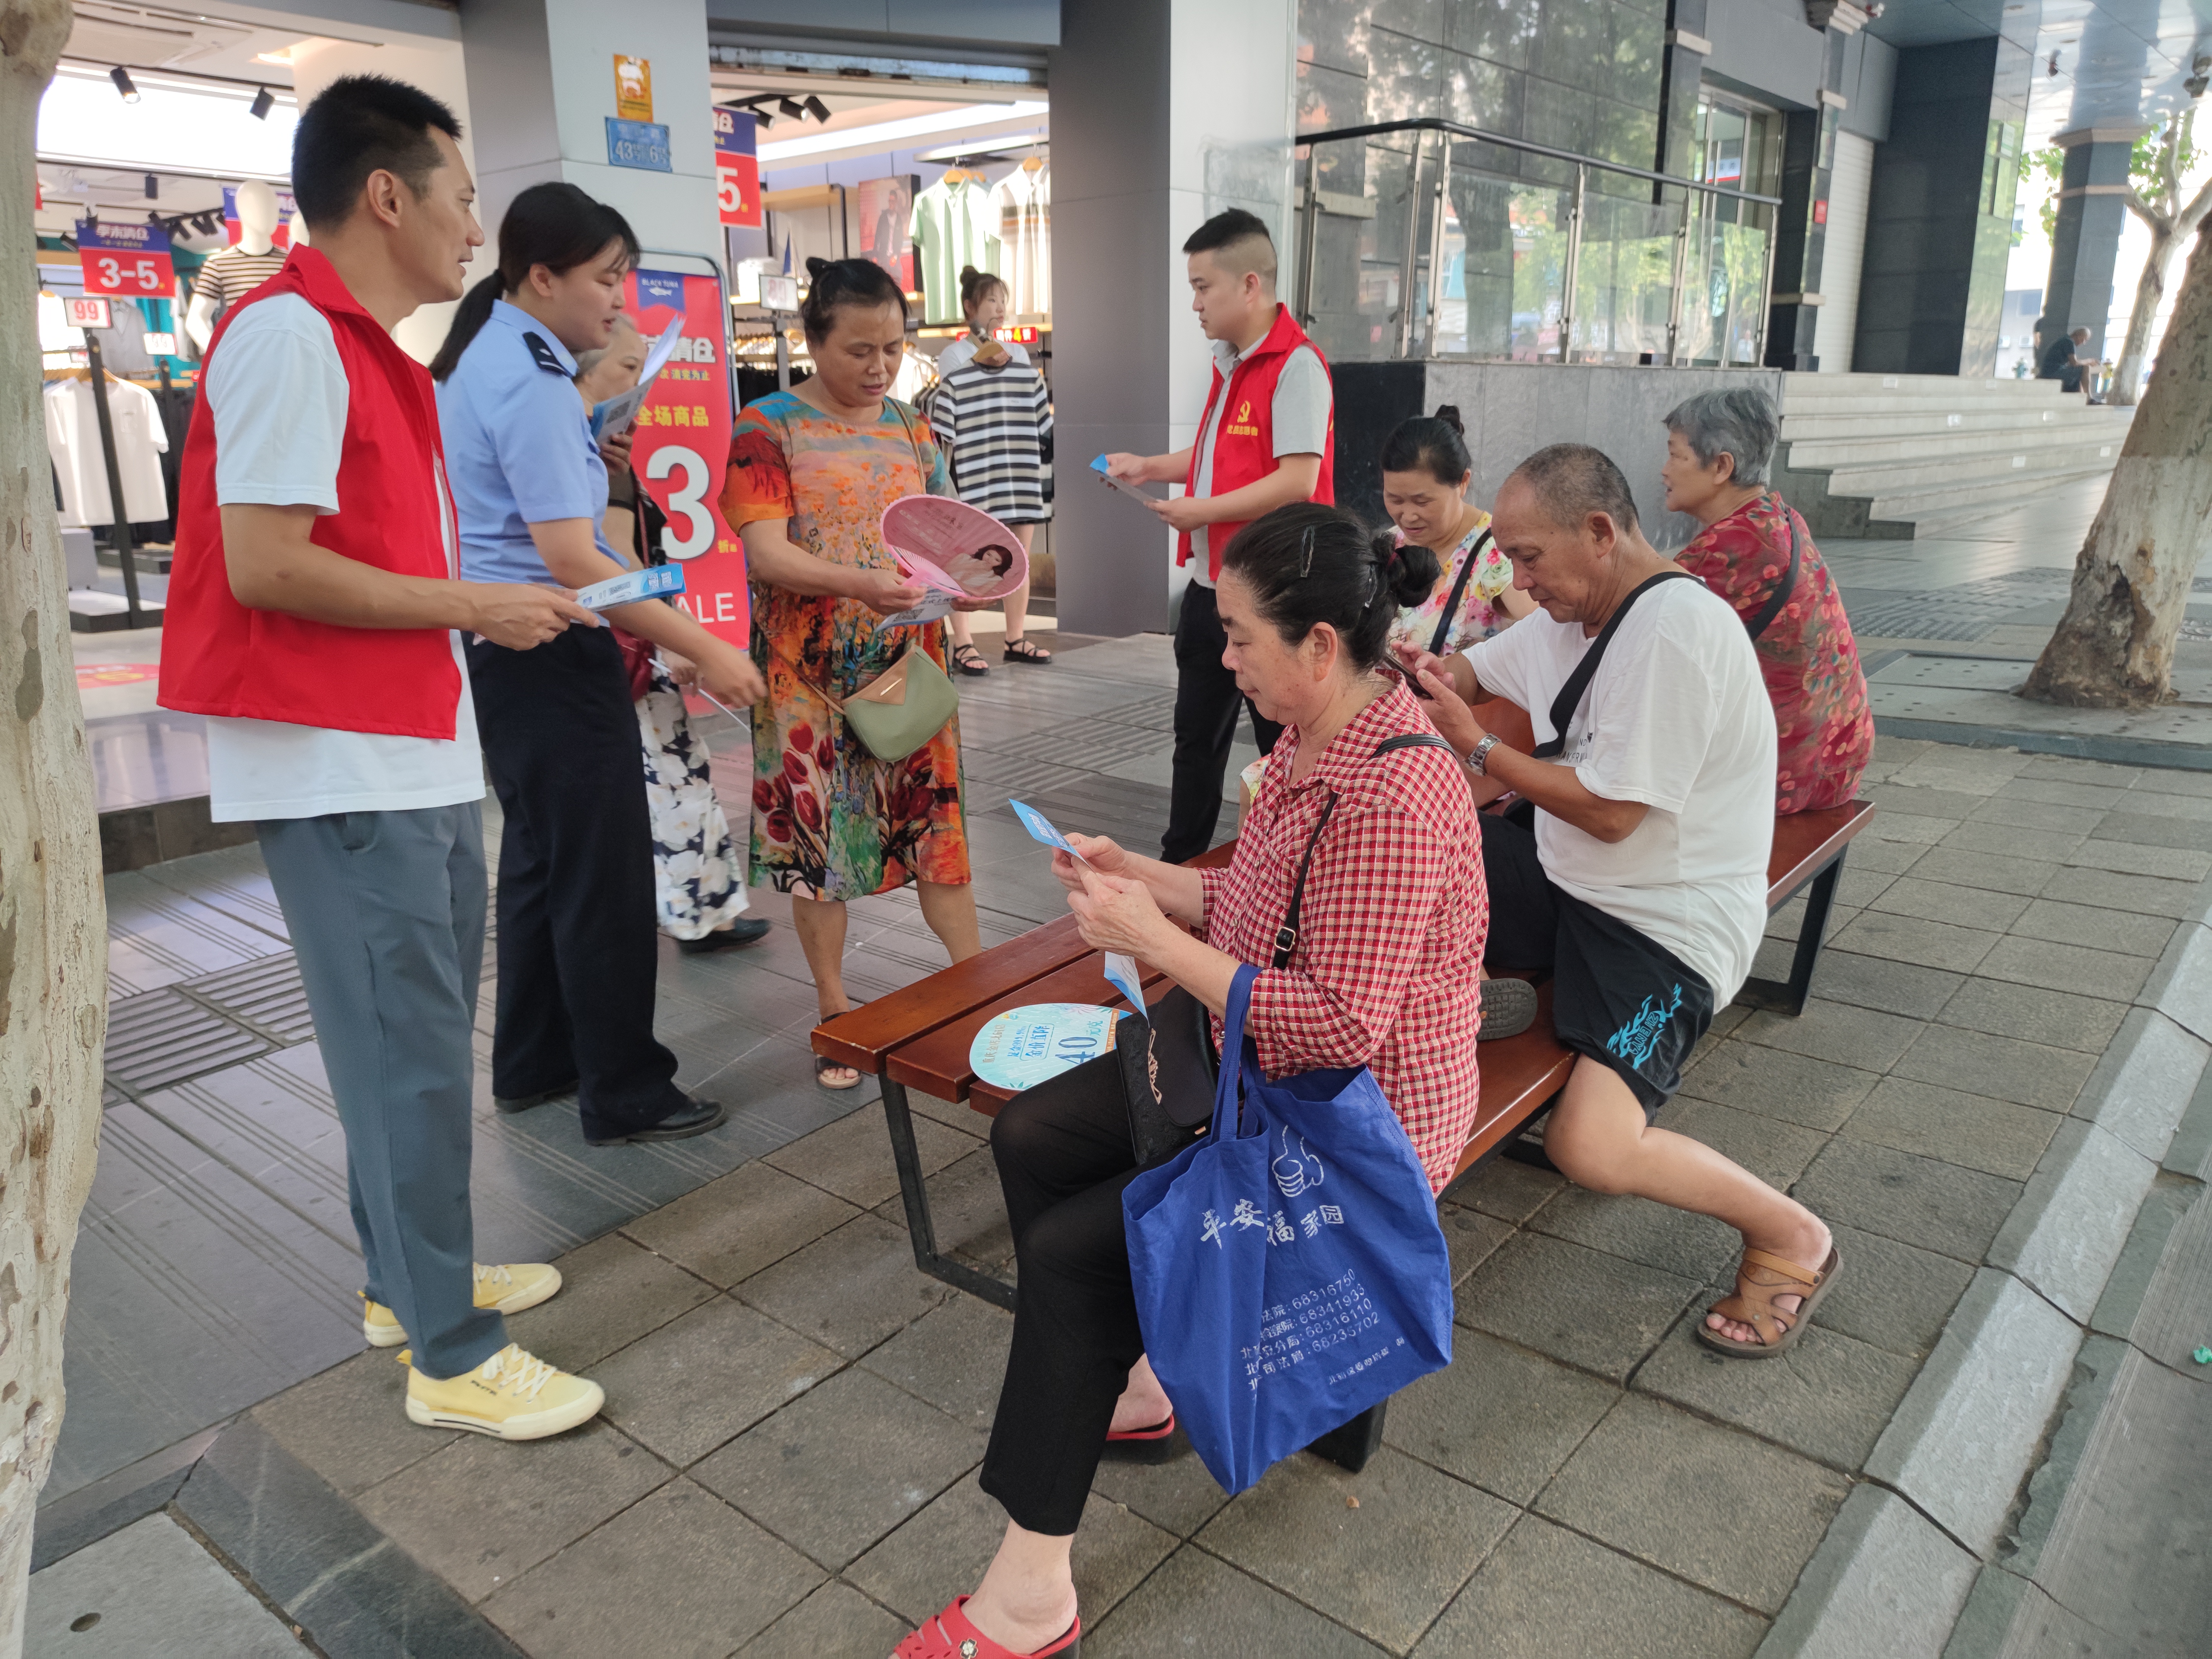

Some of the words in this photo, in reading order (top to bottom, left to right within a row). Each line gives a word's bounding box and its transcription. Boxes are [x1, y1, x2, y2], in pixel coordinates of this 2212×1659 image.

[98, 257, 159, 290] 3-5
[74, 300, 99, 321] 99
[637, 405, 709, 427] 全场商品
[646, 445, 715, 559] 3
[676, 592, 736, 624] ALE
[1025, 1025, 1051, 1057] 金价直降
[1055, 1036, 1098, 1064] 40
[1200, 1198, 1344, 1250] 平安福家园
